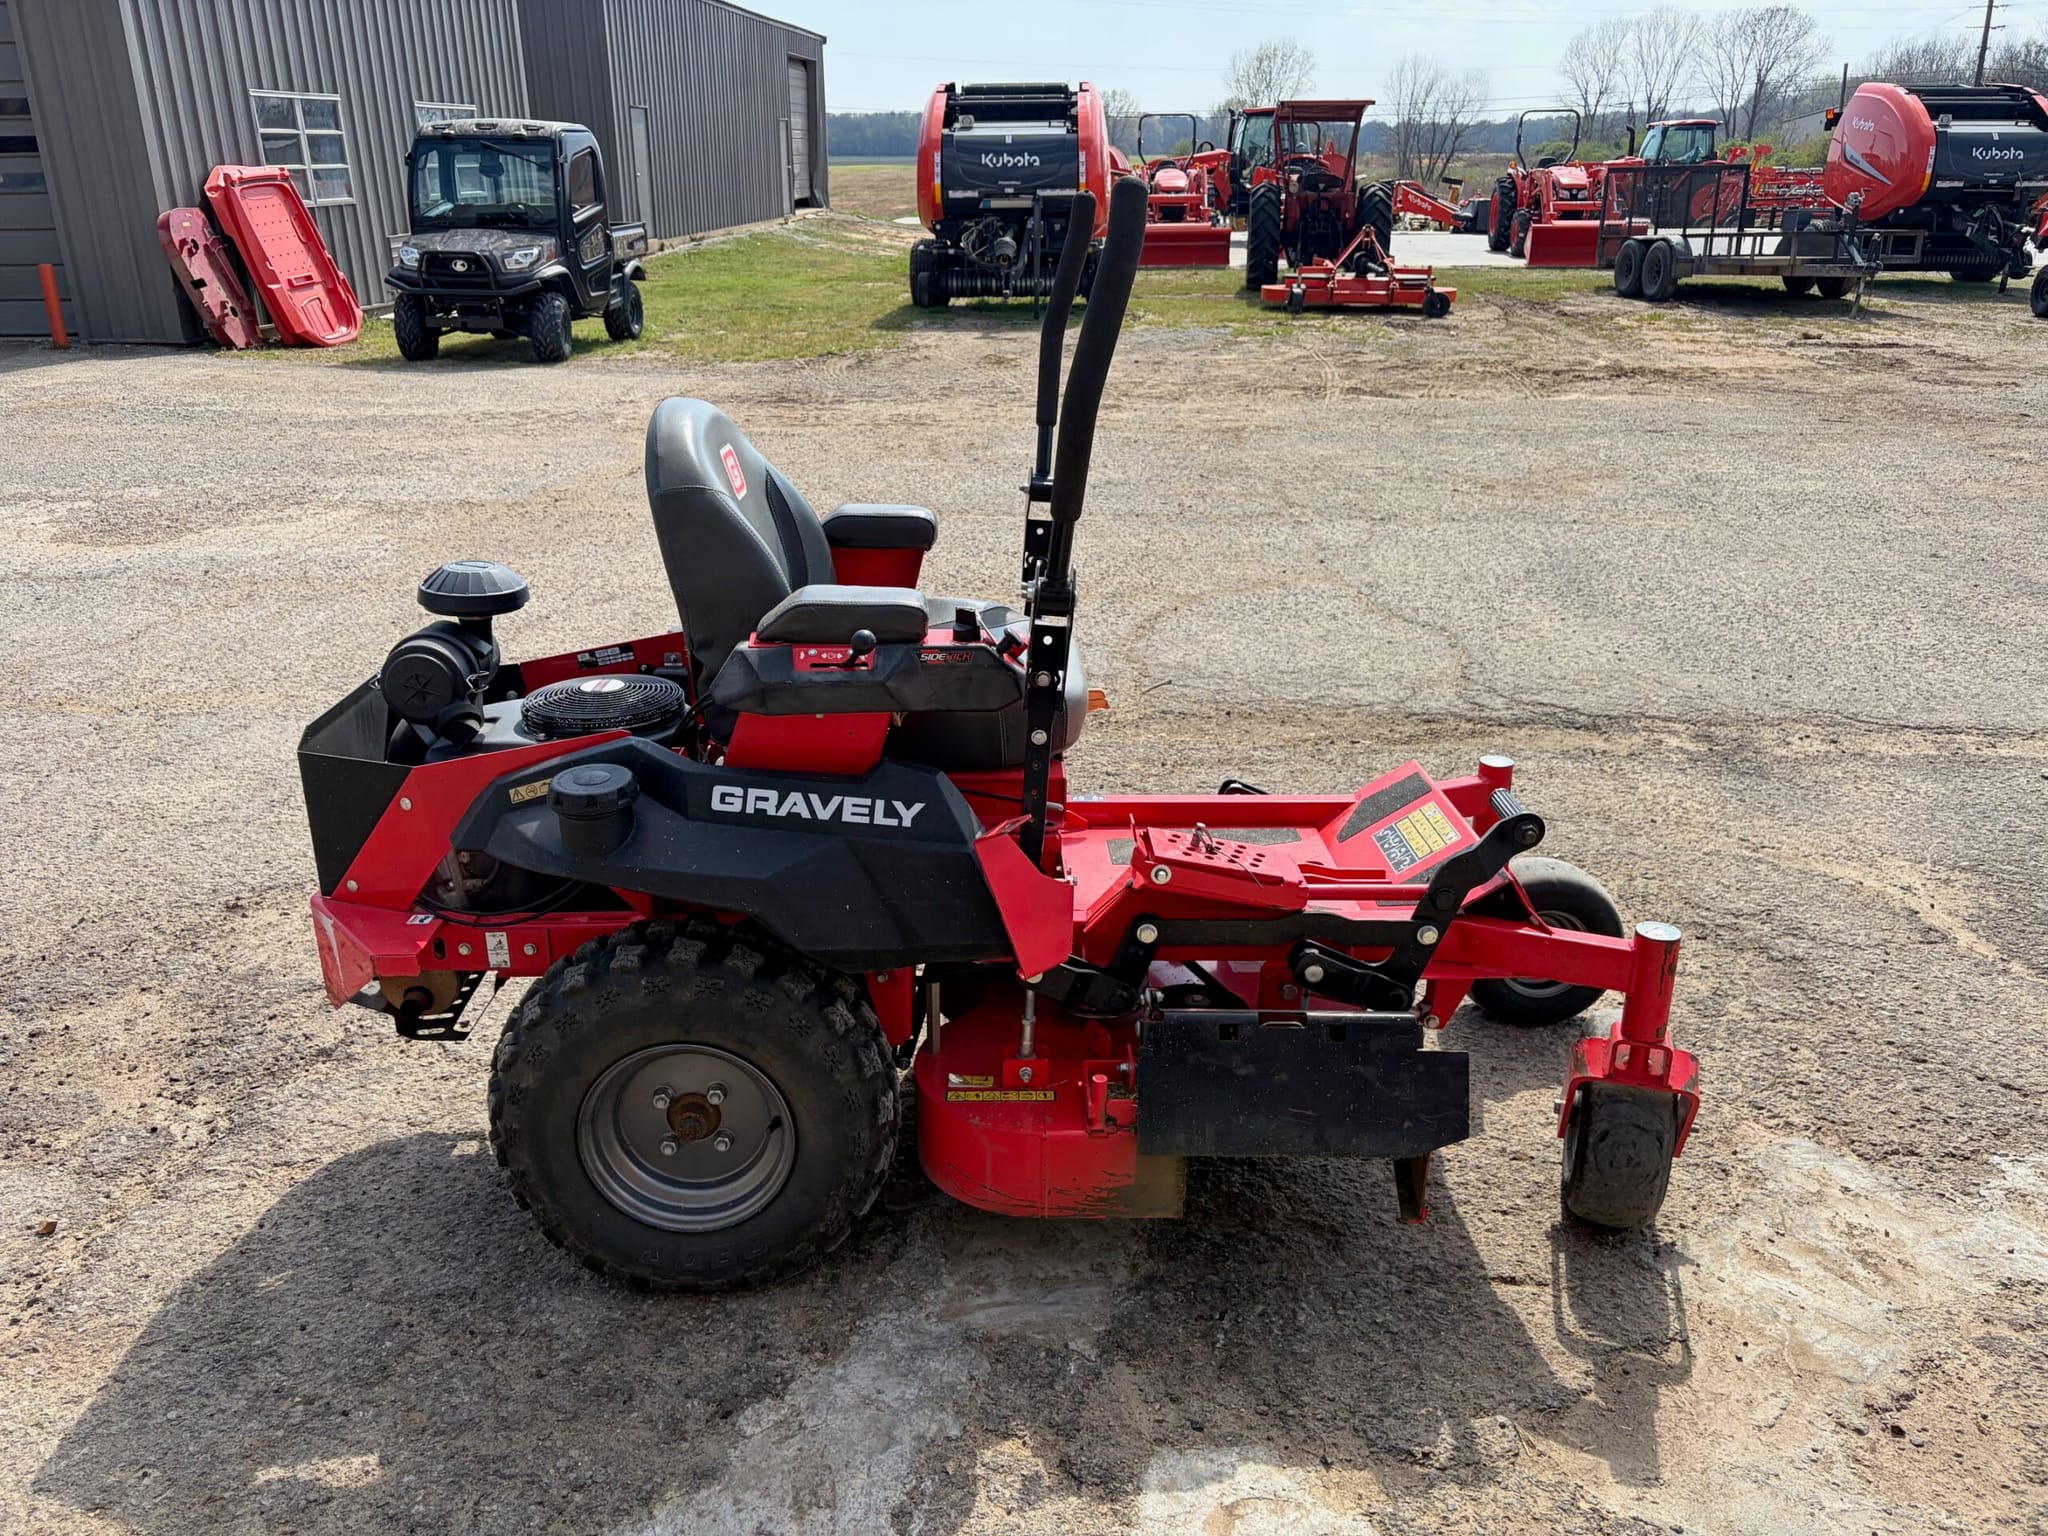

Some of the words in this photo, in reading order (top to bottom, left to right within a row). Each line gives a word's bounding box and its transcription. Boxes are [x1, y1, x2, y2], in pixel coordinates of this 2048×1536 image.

[1852, 116, 1875, 131] Kubota
[981, 152, 1041, 168] Kubota
[1972, 146, 2024, 160] Kubota
[710, 784, 927, 828] GRAVELY
